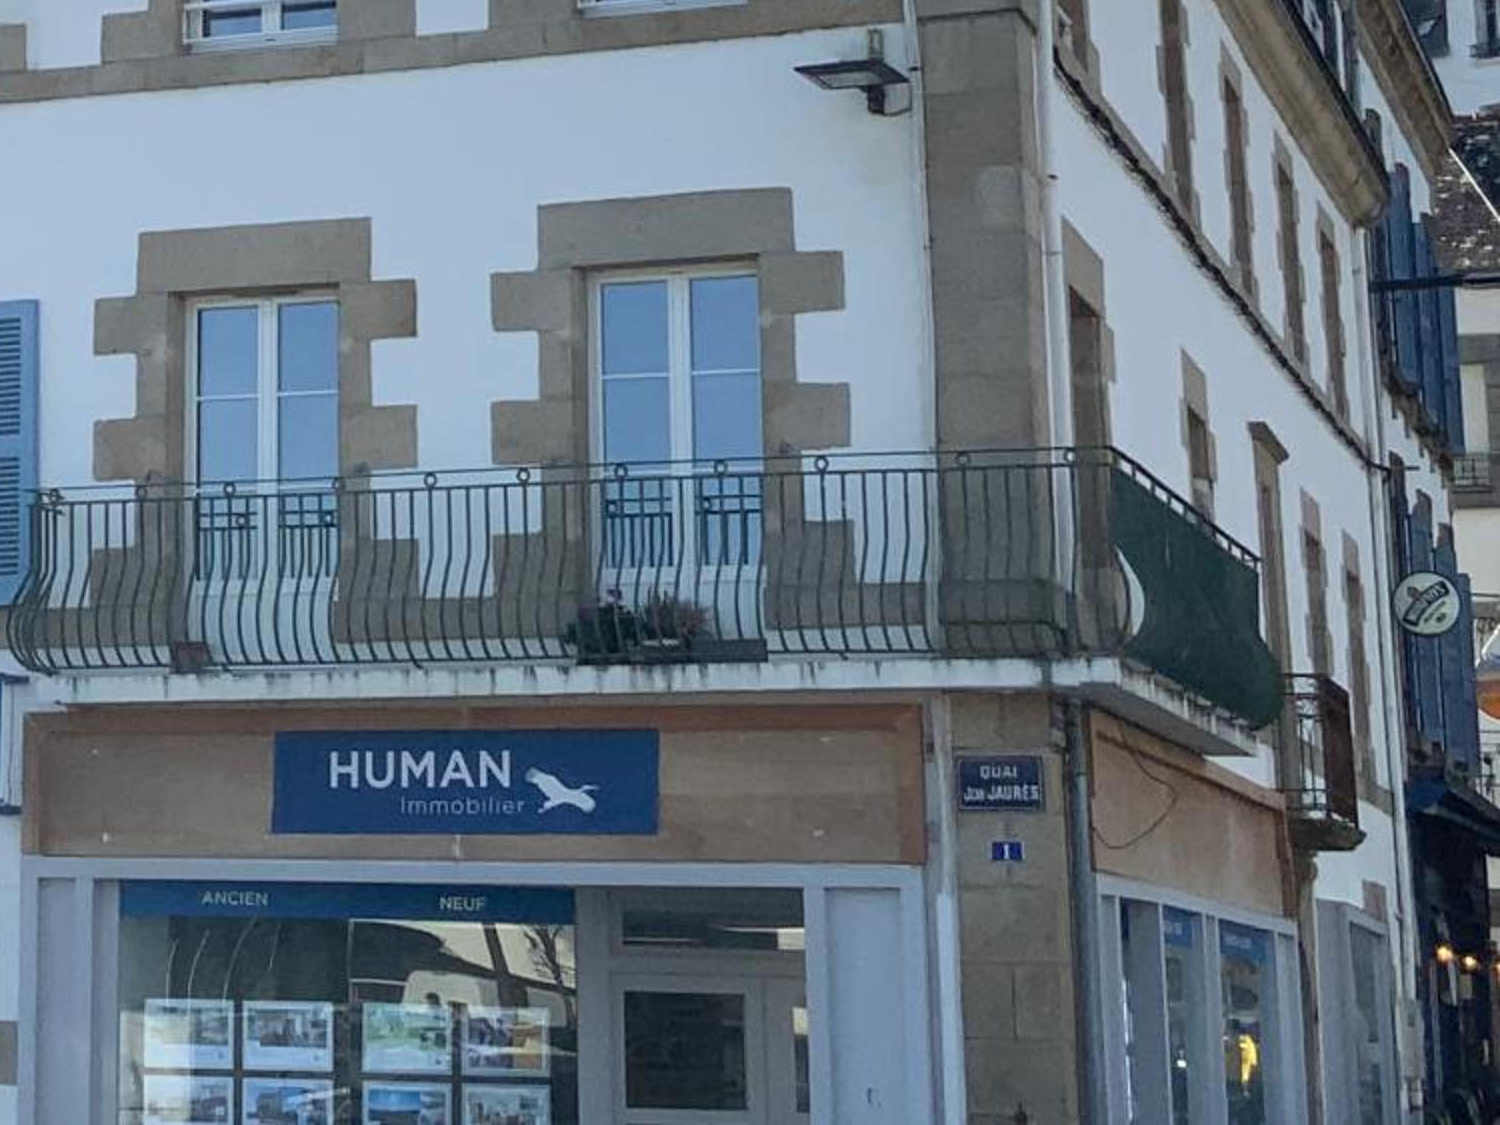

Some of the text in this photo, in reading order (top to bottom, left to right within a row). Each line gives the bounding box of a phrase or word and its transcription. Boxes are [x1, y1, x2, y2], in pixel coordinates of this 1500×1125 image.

[329, 750, 511, 789] HUMAN
[980, 765, 1018, 780] QUAI
[401, 796, 524, 815] Immobilier
[1003, 843, 1010, 859] 1
[202, 890, 268, 906] ANCIEN
[439, 896, 485, 911] NEUF
